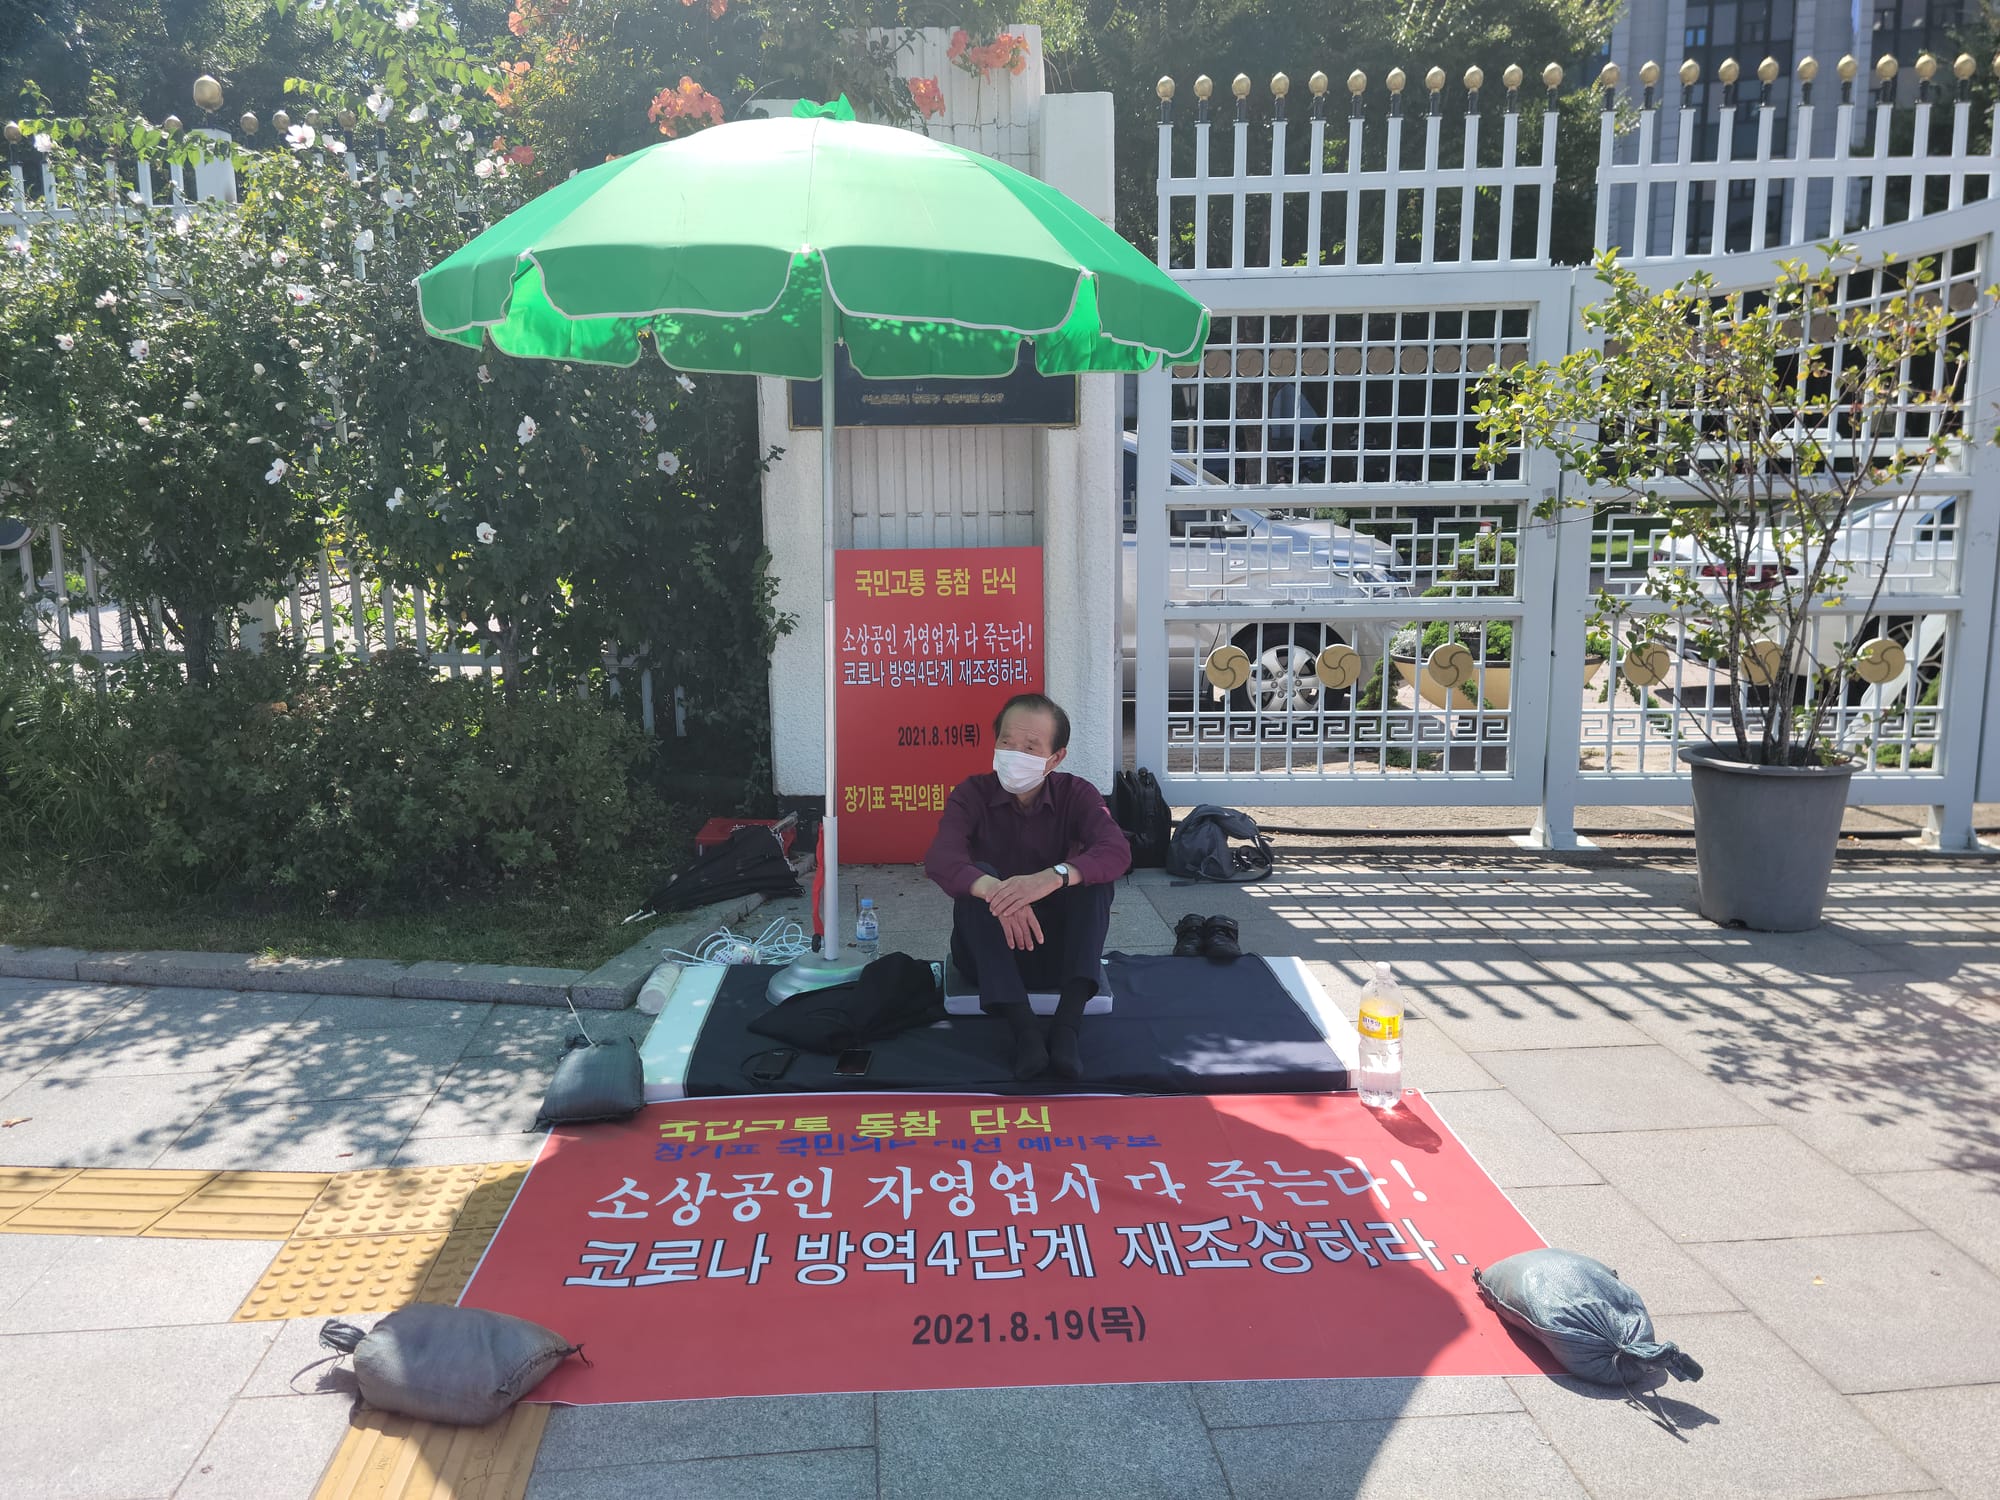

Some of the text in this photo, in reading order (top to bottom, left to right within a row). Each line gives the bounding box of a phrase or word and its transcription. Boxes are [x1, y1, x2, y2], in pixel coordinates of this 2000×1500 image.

[855, 567, 1017, 597] 국민고통 동참 단식
[842, 621, 1033, 656] 소상공인 자영업자 다 죽는다!
[843, 657, 1033, 688] 코로나 방역4단계 재조정하라.
[898, 724, 981, 747] 2021.8.19(목)
[844, 784, 945, 812] 장기표 국민의힘
[856, 1110, 941, 1138] 동참
[970, 1106, 1052, 1135] 단식
[587, 1166, 834, 1226] 소상공인
[1207, 1156, 1428, 1211] 죽는다!
[563, 1231, 773, 1288] 코로나
[795, 1223, 1097, 1287] 방역4단계
[912, 1305, 1147, 1346] 2021.8.19(목)
